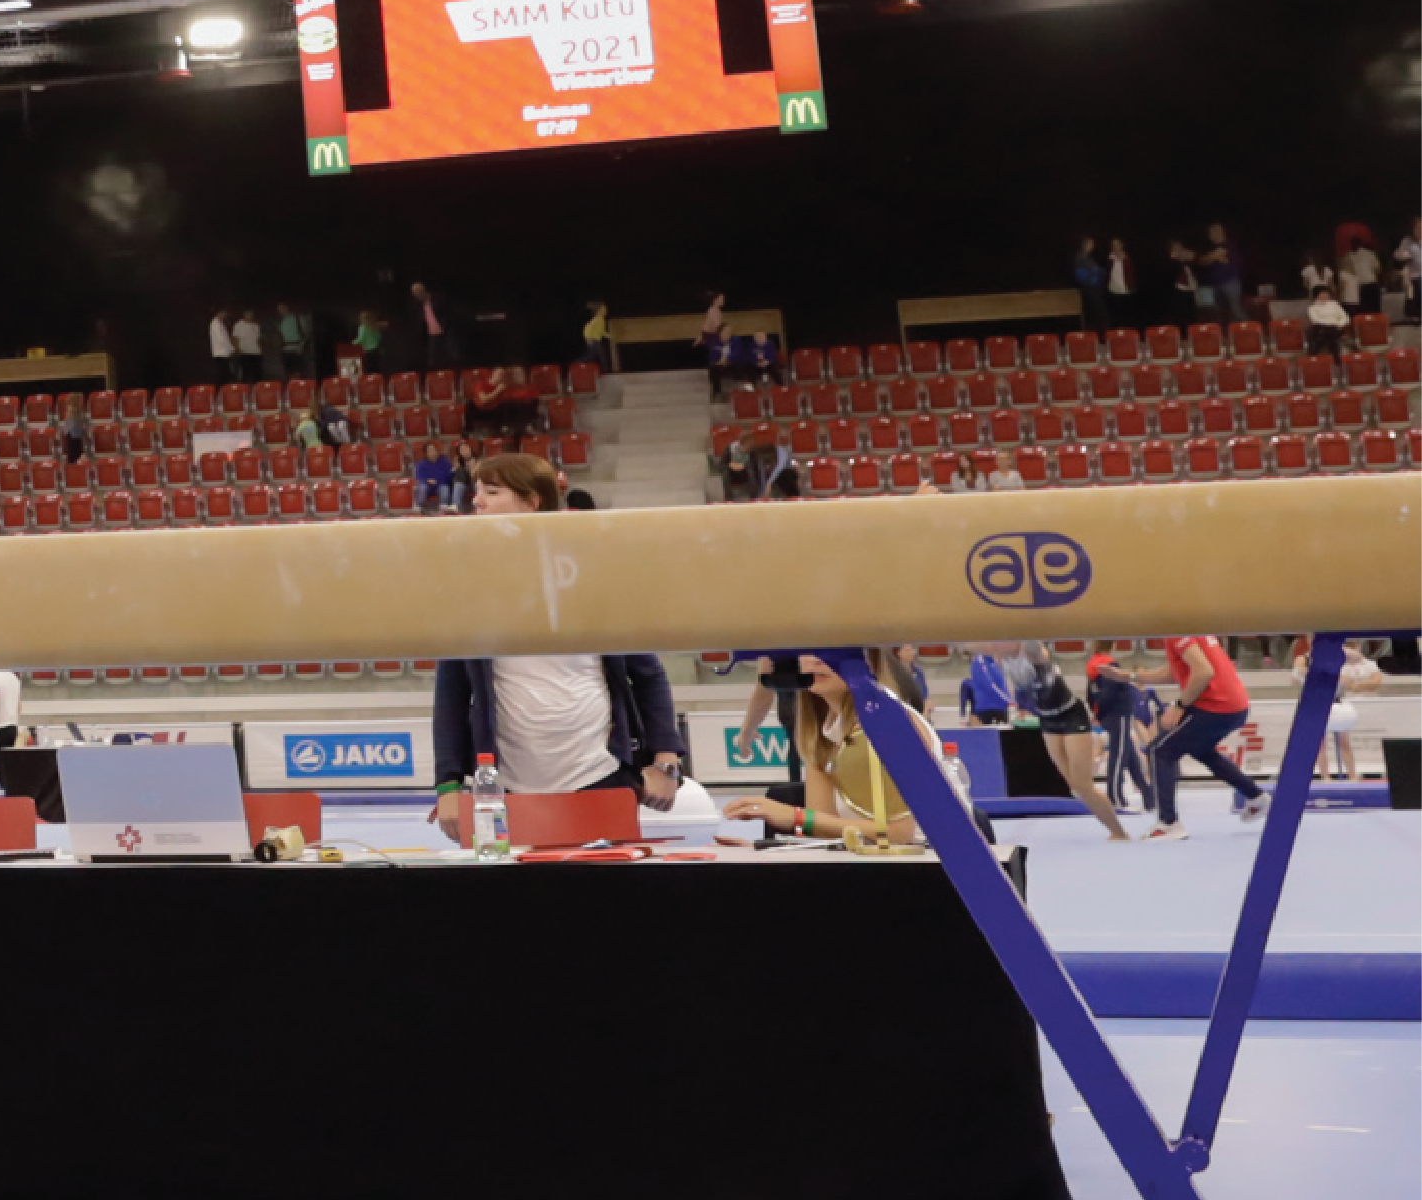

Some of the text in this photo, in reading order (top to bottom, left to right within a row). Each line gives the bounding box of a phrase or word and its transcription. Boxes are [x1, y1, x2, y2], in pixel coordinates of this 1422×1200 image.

[472, 3, 549, 32] SMM
[561, 32, 641, 66] 2021
[331, 742, 407, 766] JAKO
